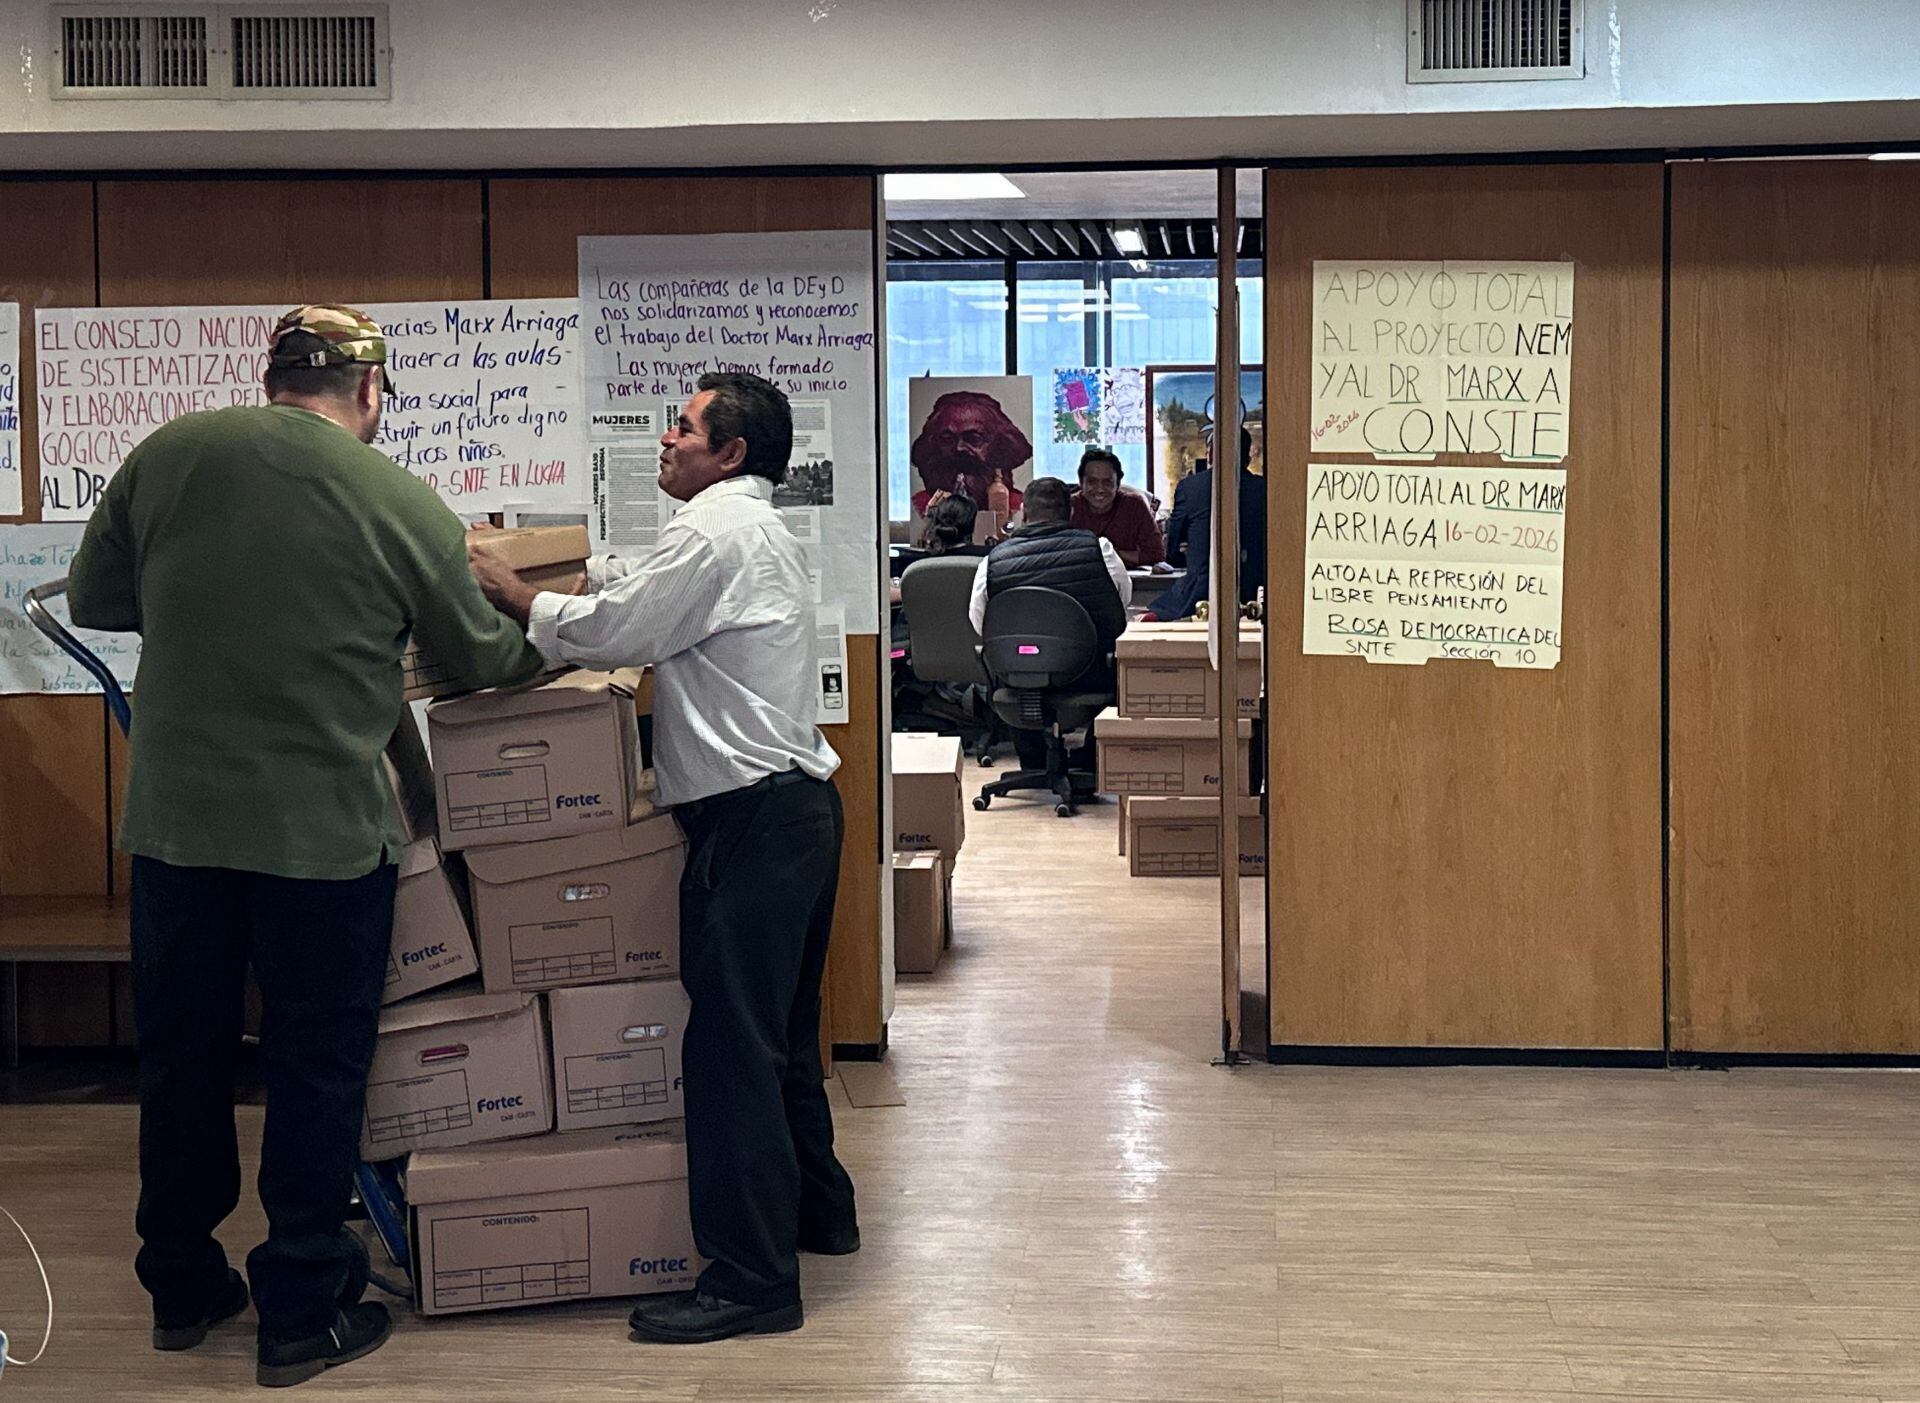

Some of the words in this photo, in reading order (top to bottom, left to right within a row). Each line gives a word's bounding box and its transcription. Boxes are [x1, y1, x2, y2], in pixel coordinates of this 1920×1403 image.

[597, 267, 629, 301] Las
[640, 278, 729, 303] compañeras
[740, 277, 759, 296] de
[767, 277, 783, 295] la
[1323, 270, 1457, 310] APOYO
[1467, 273, 1571, 318] TOTAL
[381, 318, 437, 337] acias
[445, 307, 494, 345] Marx
[501, 305, 579, 341] Arriaga
[601, 306, 629, 321] nos
[638, 302, 749, 320] solidarizamos
[769, 302, 858, 319] reconocemos
[42, 322, 69, 350] EL
[74, 318, 181, 350] CONSEJO
[199, 316, 275, 349] NACION
[595, 325, 611, 346] el
[621, 324, 680, 352] trabajo
[686, 325, 714, 344] del
[721, 327, 768, 345] Doctor
[776, 326, 812, 345] Marx
[818, 325, 873, 350] Arriaga
[1323, 321, 1358, 352] AL
[1374, 319, 1505, 355] PROYECTO
[1516, 322, 1572, 356] NEM
[387, 348, 442, 371] traer
[444, 352, 459, 367] a
[473, 342, 497, 369] las
[617, 352, 648, 376] Las
[715, 356, 761, 376] hemos
[768, 355, 834, 376] formado
[42, 360, 71, 388] DE
[81, 353, 267, 387] SISTEMATIZACIO
[1390, 363, 1421, 403] DR
[1447, 363, 1530, 401] MARX
[1536, 368, 1560, 404] A
[231, 388, 271, 407] PED
[429, 379, 480, 409] social
[490, 385, 528, 415] para
[607, 382, 645, 400] parte
[652, 380, 668, 395] de
[679, 378, 693, 396] la
[808, 380, 847, 391] inicio
[41, 394, 52, 426] Y
[63, 390, 216, 427] ELABORACIONES
[593, 415, 650, 425] MUJERES
[374, 420, 424, 445] struir
[432, 421, 451, 435] un
[457, 408, 509, 440] futuro
[518, 403, 567, 437] digno
[500, 463, 519, 487] EN
[526, 459, 566, 485] LUCHA
[41, 476, 71, 509] AL
[1312, 470, 1380, 502] APOYO
[1483, 480, 1511, 507] DR
[1520, 482, 1565, 510] MARX
[1311, 512, 1437, 549] ARRIAGA
[1446, 520, 1558, 553] 16-02-2026
[1410, 568, 1505, 592] REPRESIÓN
[1517, 574, 1548, 595] DEL
[1312, 587, 1374, 604] LIBRE
[1389, 591, 1508, 614] PENSAMIENTO
[1401, 619, 1530, 643] DEMOCRATICA
[1347, 640, 1397, 657] SNTE
[1515, 649, 1536, 664] 10
[1203, 775, 1219, 784] For
[556, 794, 601, 809] Fortec
[899, 833, 931, 844] Fortec
[1239, 853, 1263, 864] Forte
[402, 942, 447, 966] Fortec
[625, 950, 661, 962] Fortec
[477, 1095, 523, 1113] Fortec
[629, 1258, 687, 1275] Fortec
